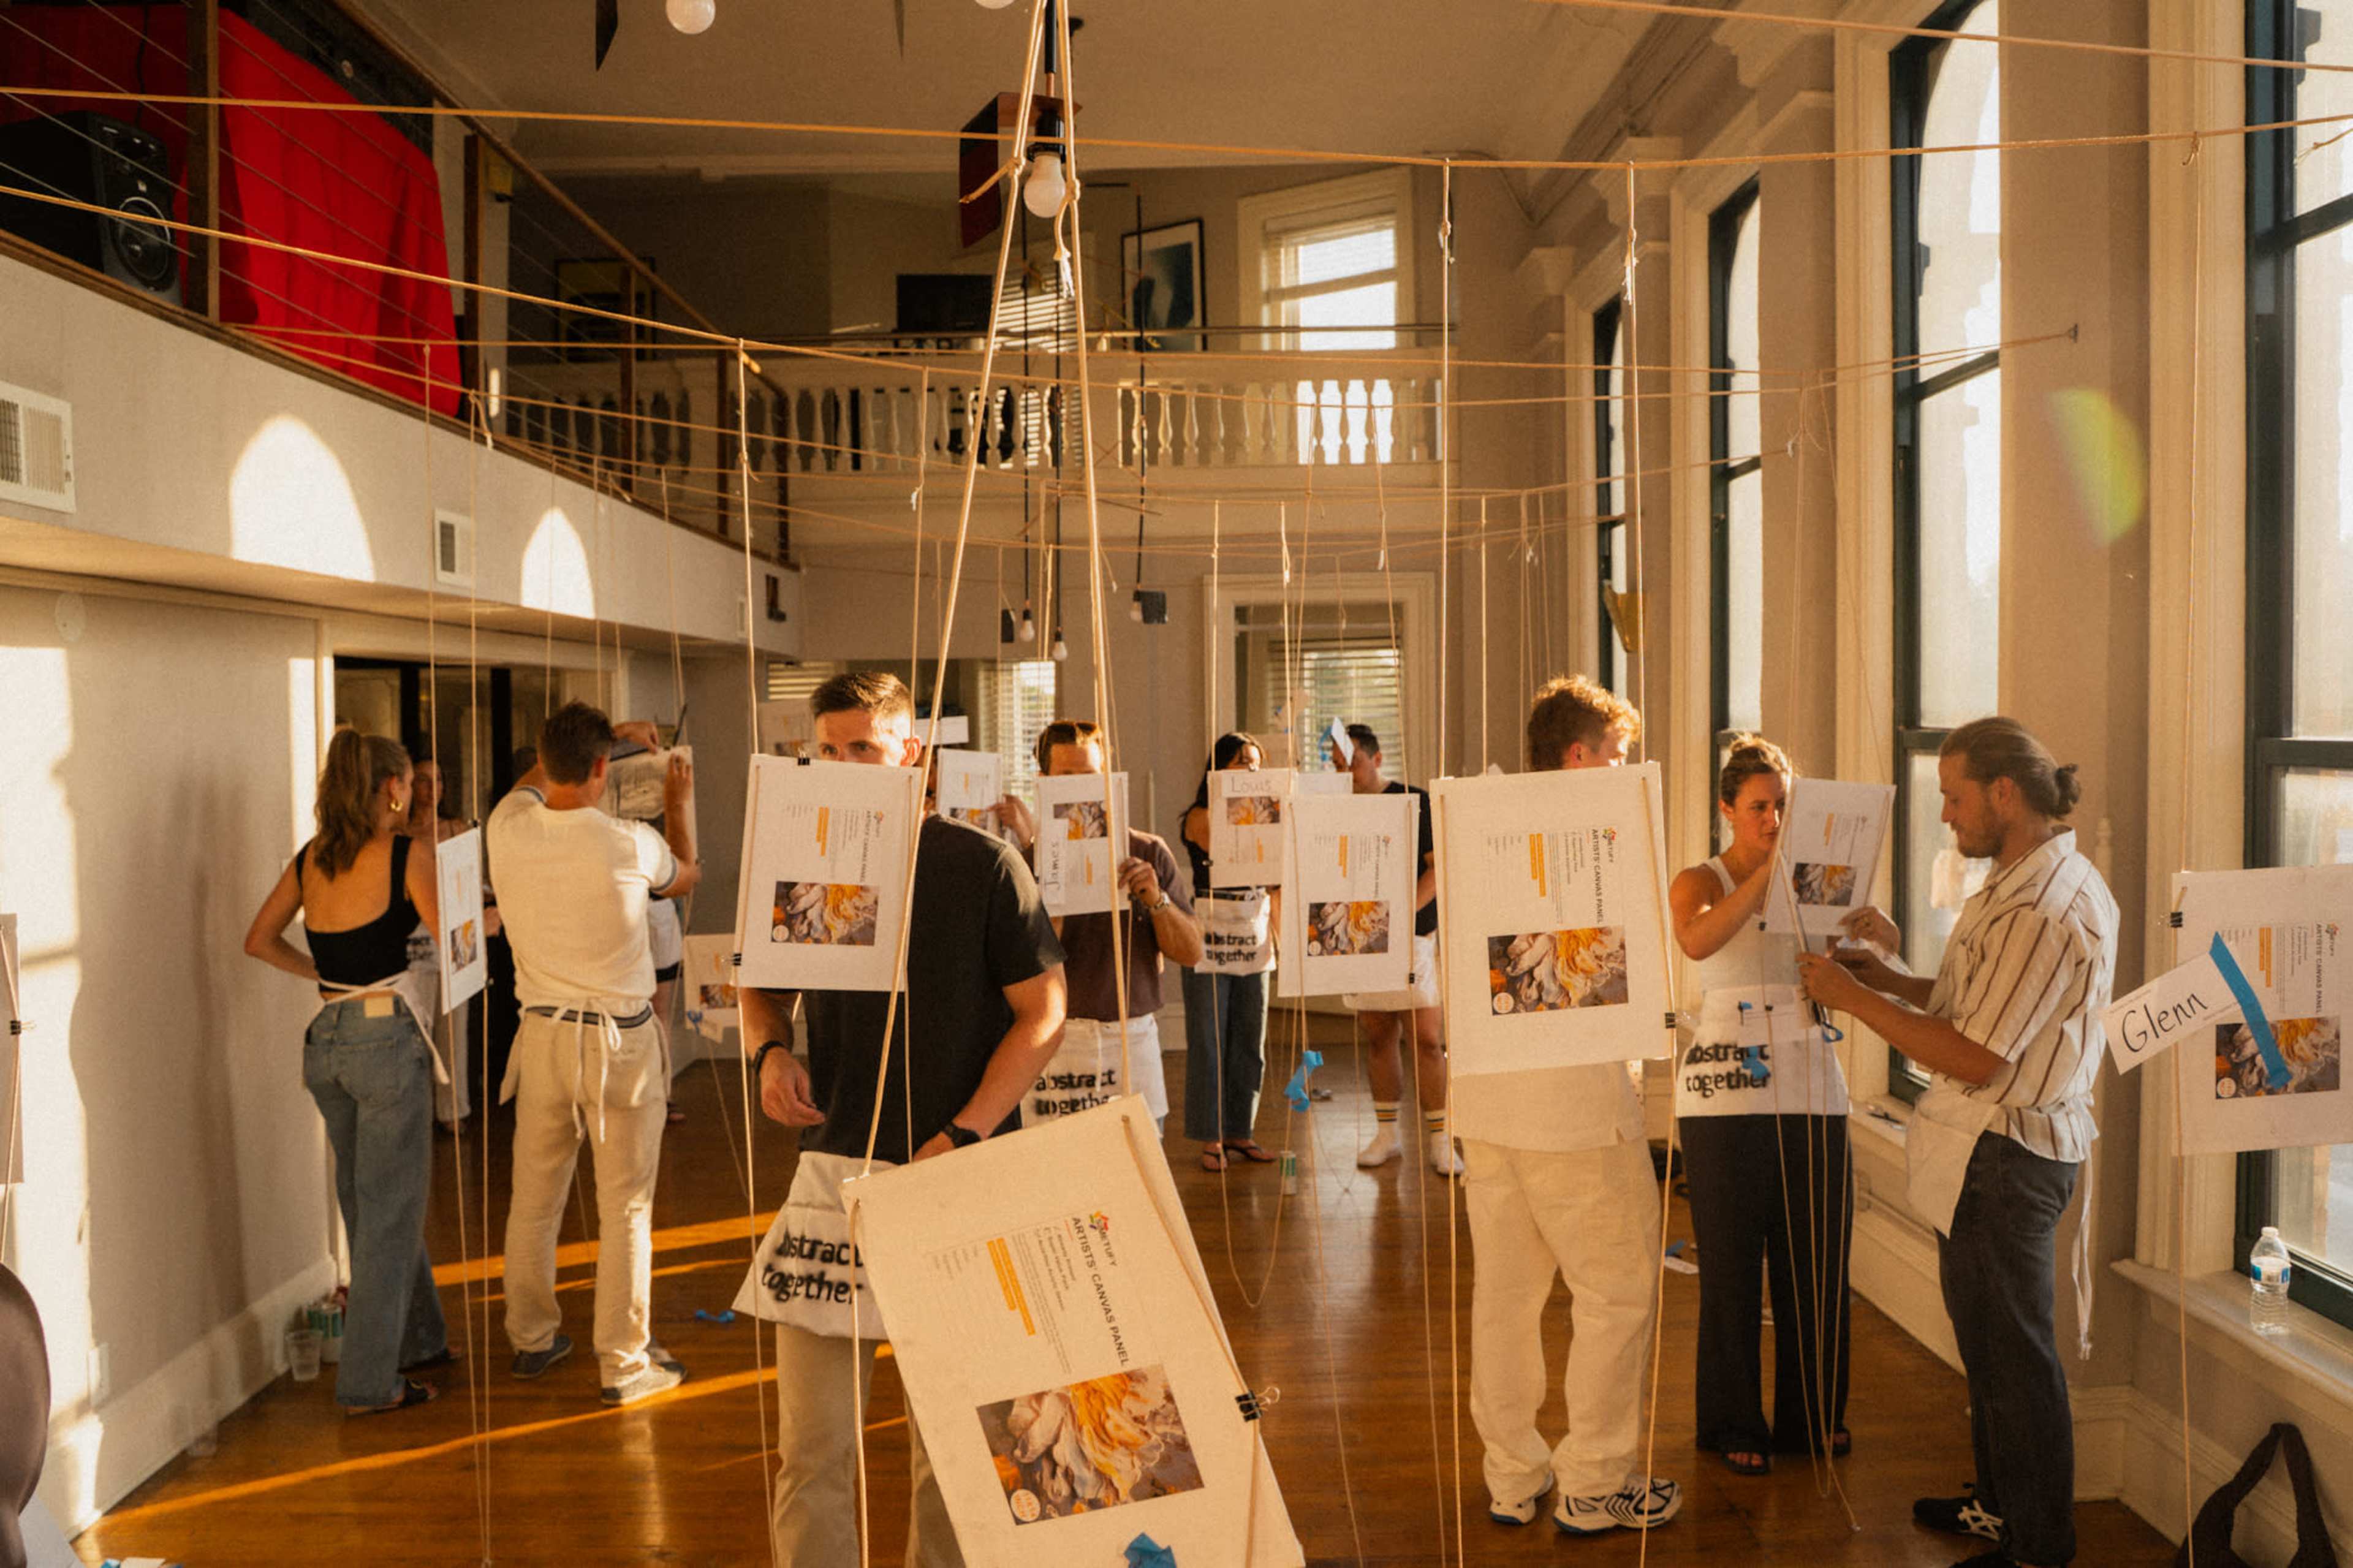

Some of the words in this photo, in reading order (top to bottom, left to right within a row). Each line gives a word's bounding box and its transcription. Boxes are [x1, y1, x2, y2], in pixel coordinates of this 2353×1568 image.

[1044, 841, 1061, 890] James
[1594, 865, 1603, 896] CANVAS
[2121, 993, 2208, 1053] Glenn
[1036, 1093, 1110, 1116] togethe
[1072, 1217, 1097, 1271] ARTISTS'
[1091, 1273, 1116, 1324] CANVAS
[1110, 1326, 1129, 1366] PANEL
